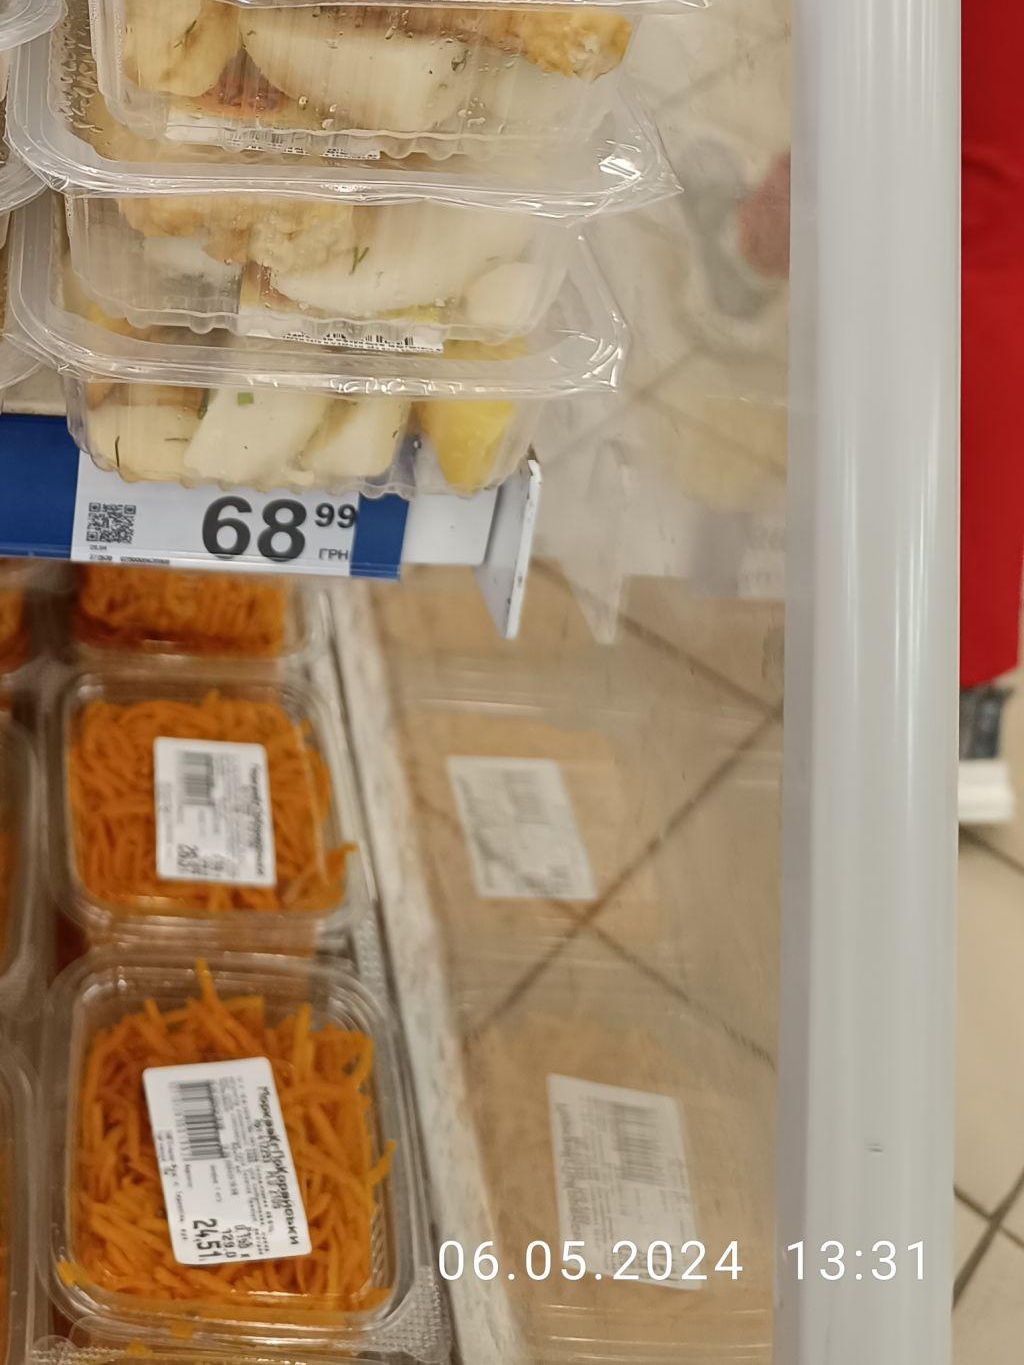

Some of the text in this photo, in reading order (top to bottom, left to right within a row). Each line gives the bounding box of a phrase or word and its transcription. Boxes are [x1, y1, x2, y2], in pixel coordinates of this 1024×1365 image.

[201, 494, 358, 562] 68 99
[318, 547, 349, 562] ГРН
